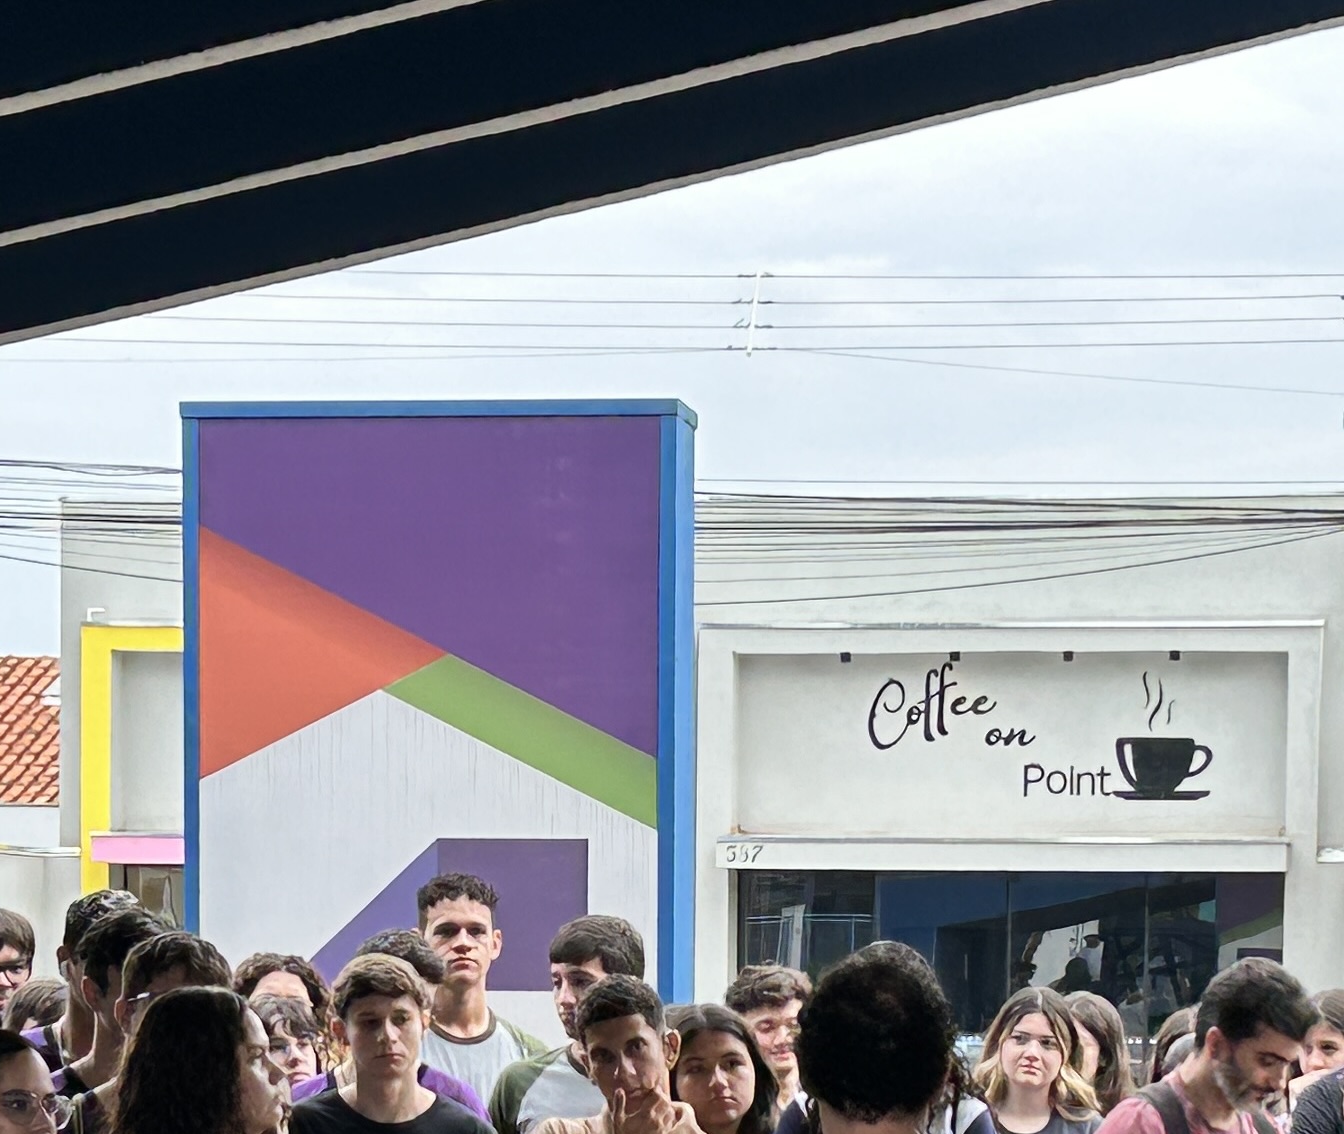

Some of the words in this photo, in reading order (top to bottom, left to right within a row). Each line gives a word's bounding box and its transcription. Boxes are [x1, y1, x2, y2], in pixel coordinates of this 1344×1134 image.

[868, 662, 997, 750] Coffee
[985, 727, 1035, 747] on
[1023, 764, 1112, 797] Point
